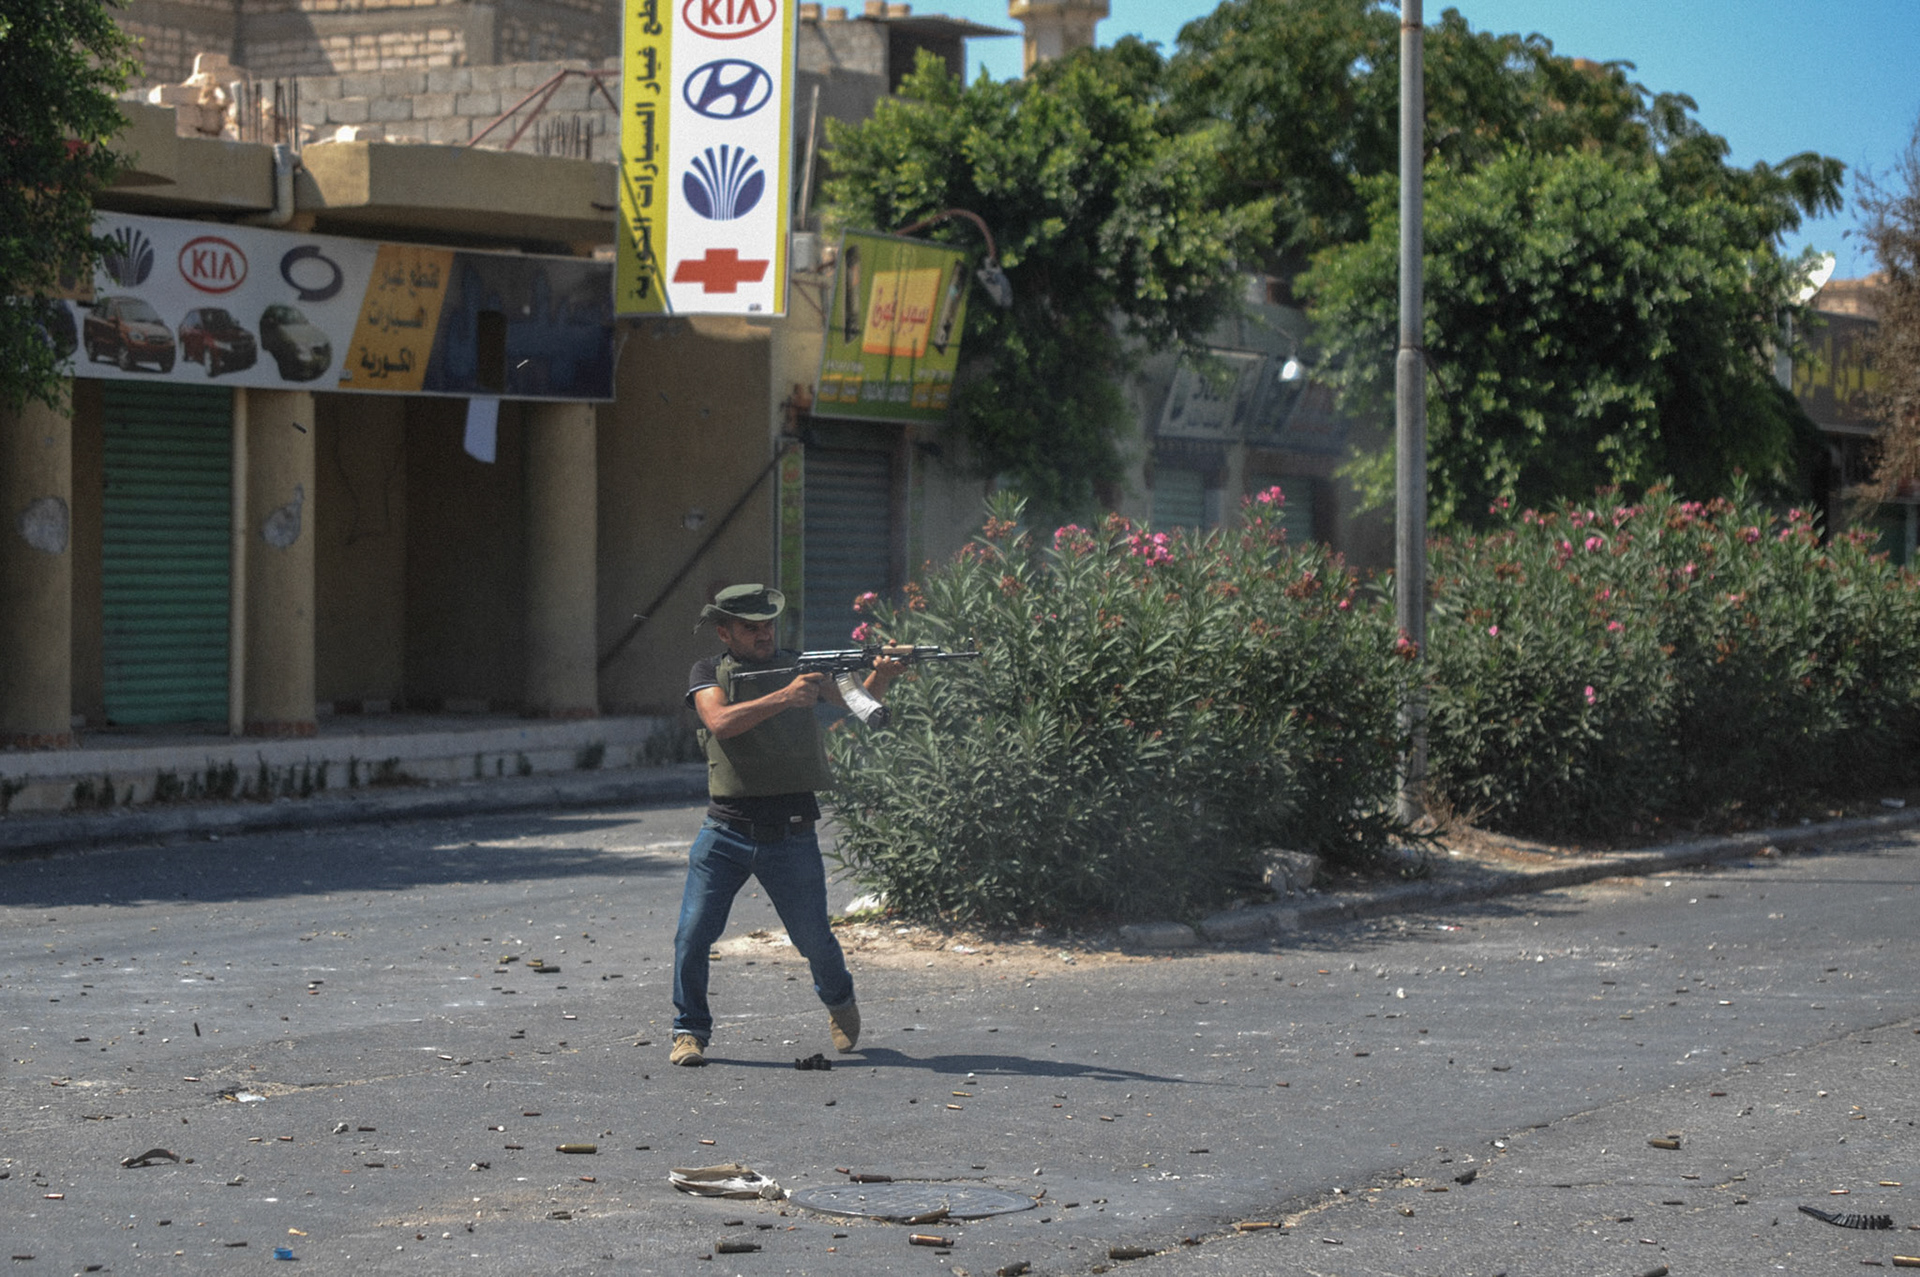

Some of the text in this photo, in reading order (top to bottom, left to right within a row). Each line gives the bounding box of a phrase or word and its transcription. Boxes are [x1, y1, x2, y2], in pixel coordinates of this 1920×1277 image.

[637, 0, 663, 35] طع
[701, 0, 762, 26] KIA
[636, 46, 661, 94] غيار
[634, 101, 659, 208] السيارات
[192, 248, 237, 280] KIA
